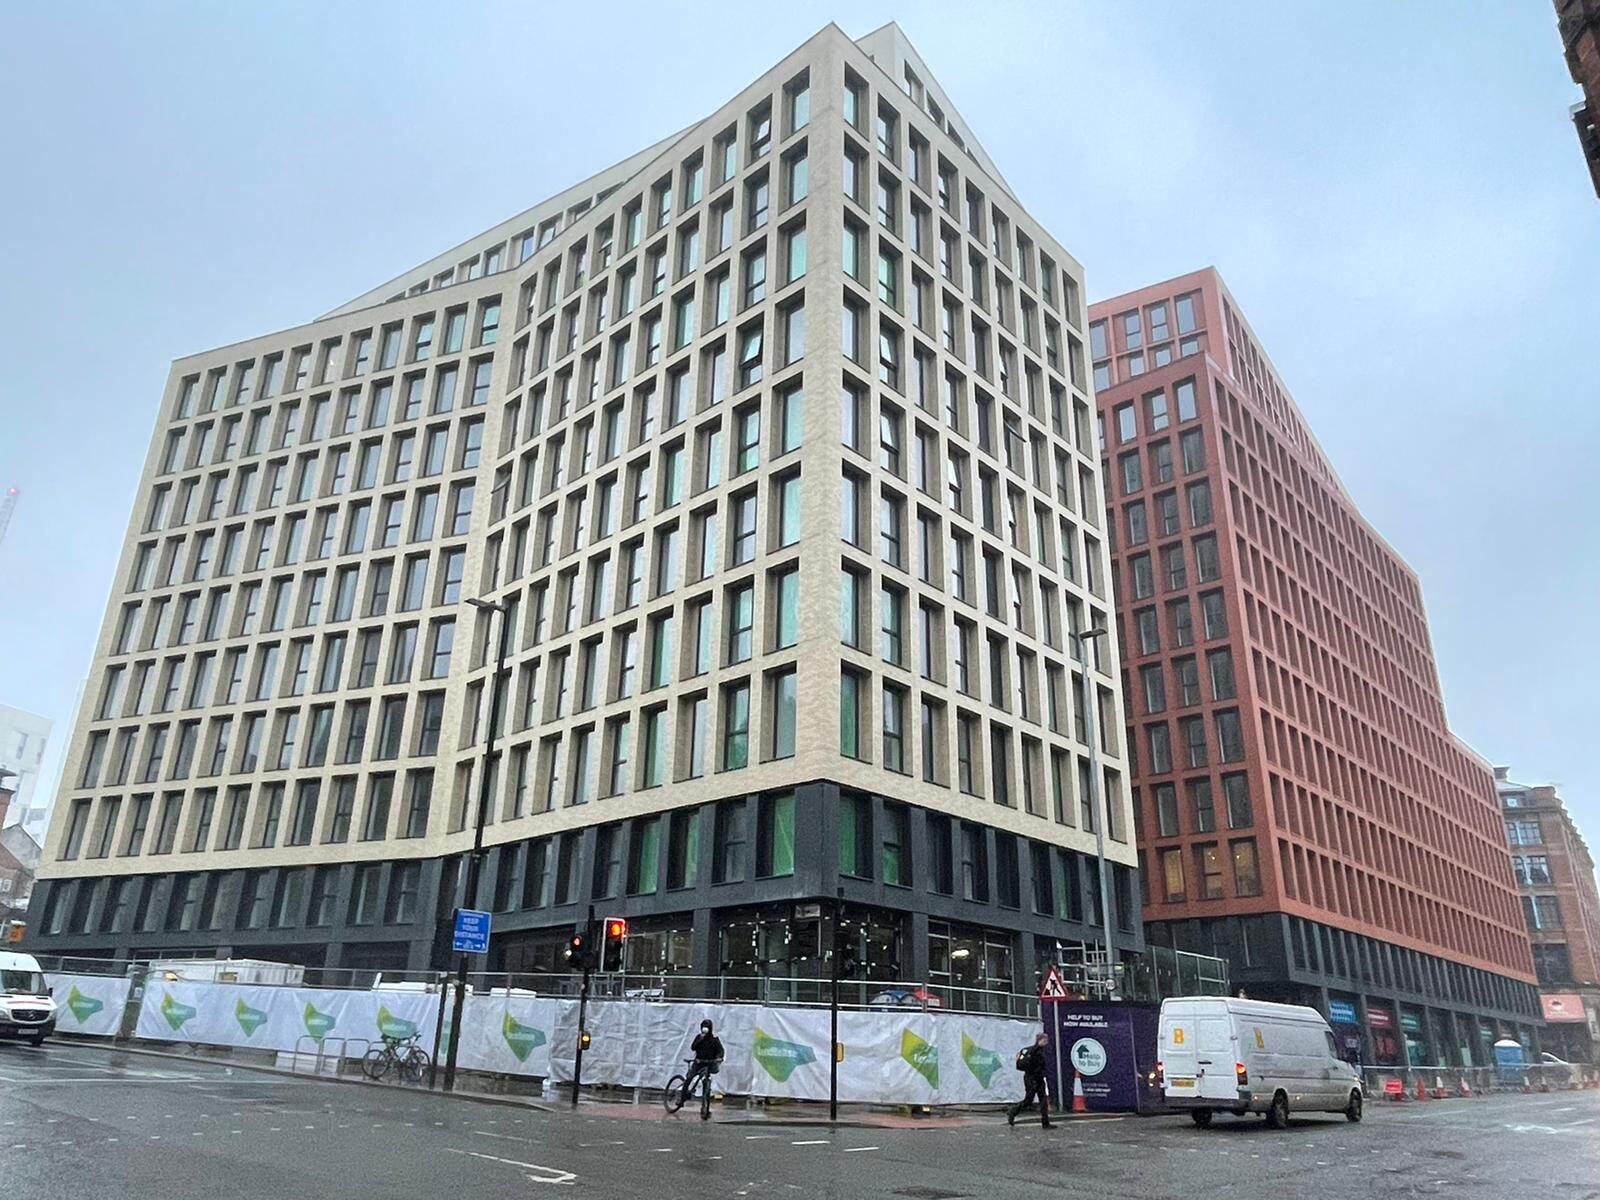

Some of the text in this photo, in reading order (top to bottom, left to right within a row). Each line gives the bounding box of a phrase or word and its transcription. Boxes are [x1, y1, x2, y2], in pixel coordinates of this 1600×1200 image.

[1091, 1014, 1104, 1022] BUY
[1083, 1052, 1101, 1060] Help
[1087, 1060, 1101, 1068] Buy
